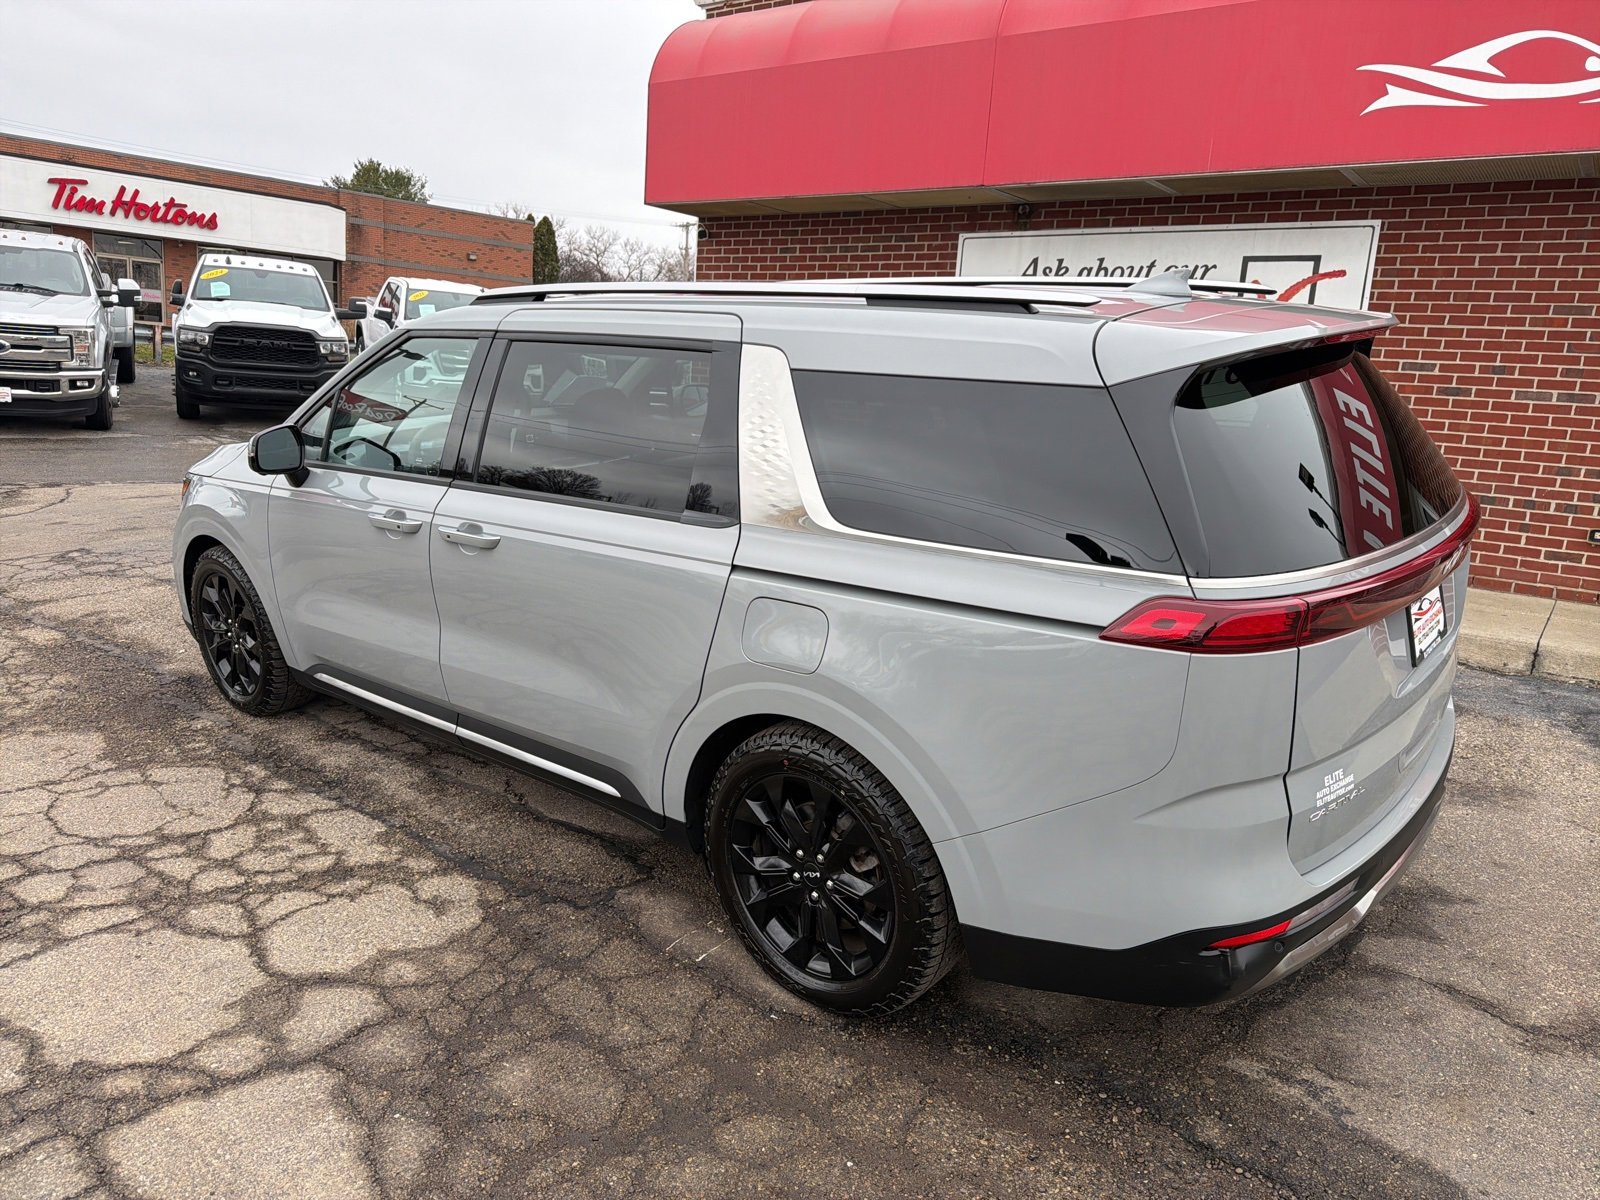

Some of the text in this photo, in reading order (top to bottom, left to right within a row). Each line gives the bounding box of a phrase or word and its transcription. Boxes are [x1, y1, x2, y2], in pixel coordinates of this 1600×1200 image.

[47, 178, 218, 230] Tim Hortons
[1021, 256, 1217, 280] Ask about ur
[1316, 773, 1354, 799] AUTO EXCHANGE
[1324, 768, 1344, 786] ELITE
